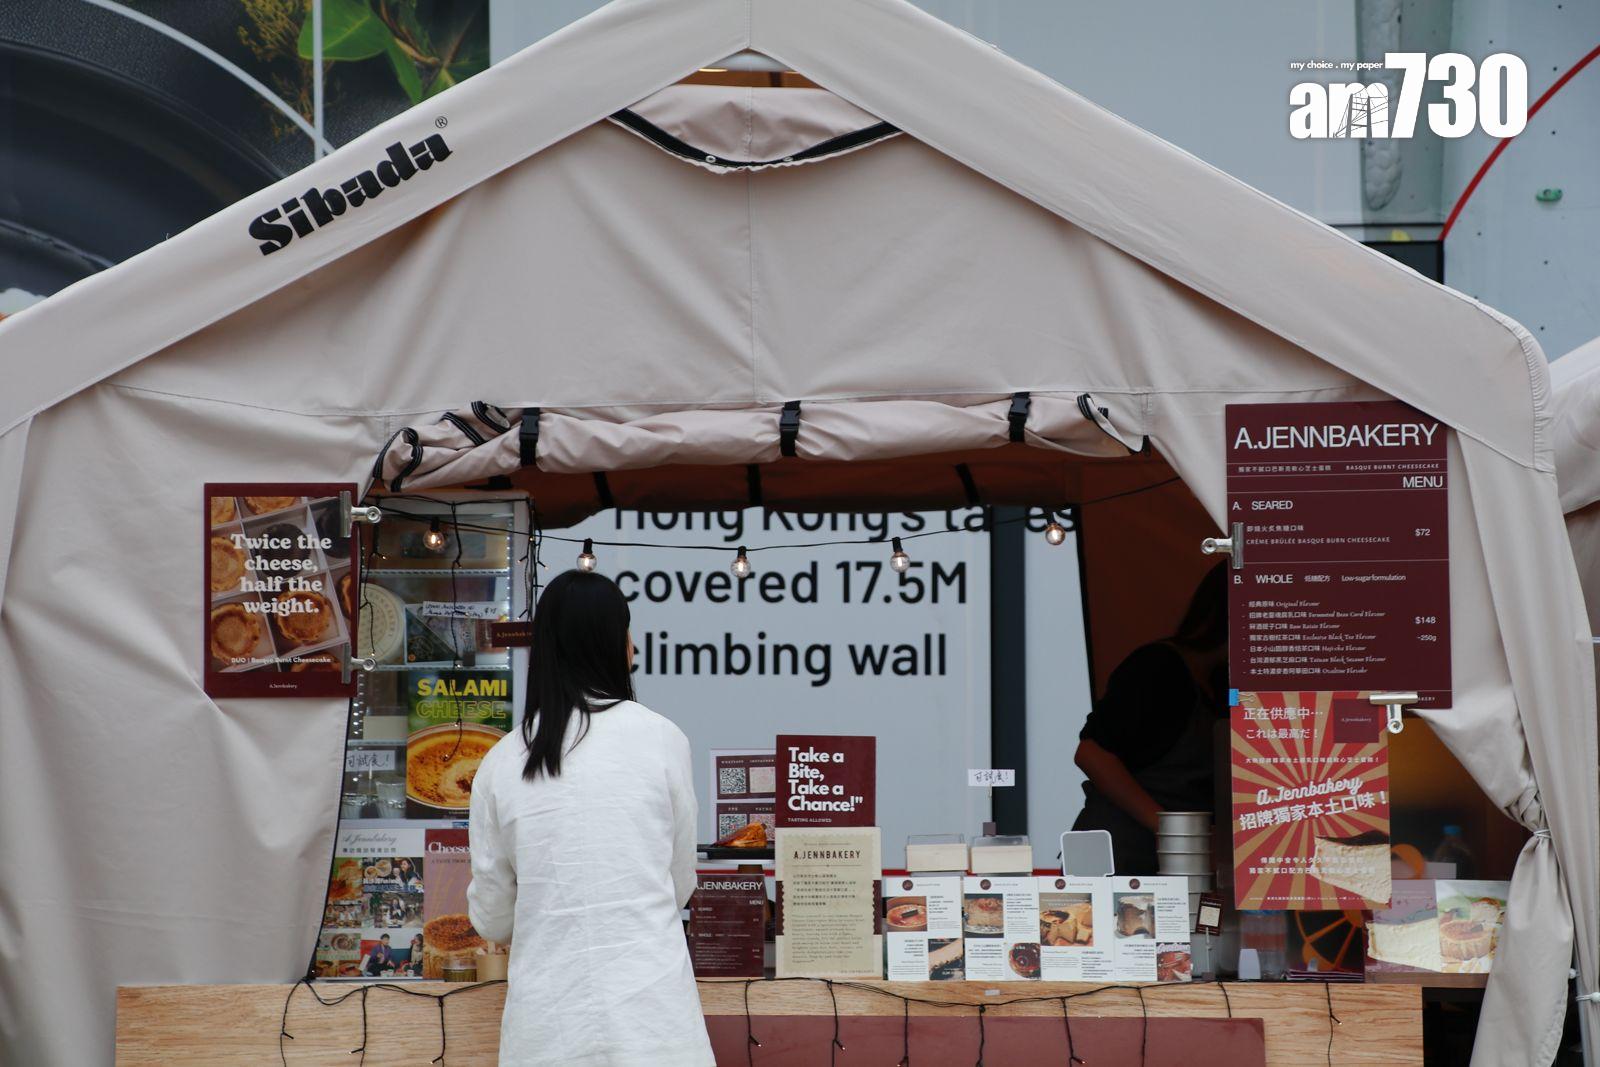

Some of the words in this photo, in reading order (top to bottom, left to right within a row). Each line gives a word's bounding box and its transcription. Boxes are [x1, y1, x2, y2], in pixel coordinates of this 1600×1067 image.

[1234, 423, 1439, 449] A.JENNBAKERY
[1402, 475, 1444, 488] MENU
[1251, 500, 1294, 511] SEARED
[1415, 528, 1431, 536] $72
[230, 533, 292, 550] Twice
[296, 533, 332, 550] the
[1297, 537, 1325, 545] BASQUE
[1347, 536, 1391, 544] CHEESECAKE
[244, 555, 319, 573] cheese,
[239, 576, 285, 592] half
[286, 576, 323, 592] the
[615, 561, 819, 604] covered
[835, 561, 967, 604] 17.5M
[1255, 574, 1294, 584] WHOLE
[242, 597, 320, 617] weight.
[1414, 616, 1437, 624] $148
[848, 633, 947, 676] wall
[417, 678, 508, 697] SALAMI
[415, 700, 507, 719] CHEESE
[787, 747, 830, 763] Take
[832, 751, 844, 763] a
[788, 763, 825, 781] Bite,
[787, 779, 830, 795] Take
[832, 783, 844, 795] a
[787, 795, 864, 812] Chance!"
[793, 850, 861, 859] A.JENNBAKERY
